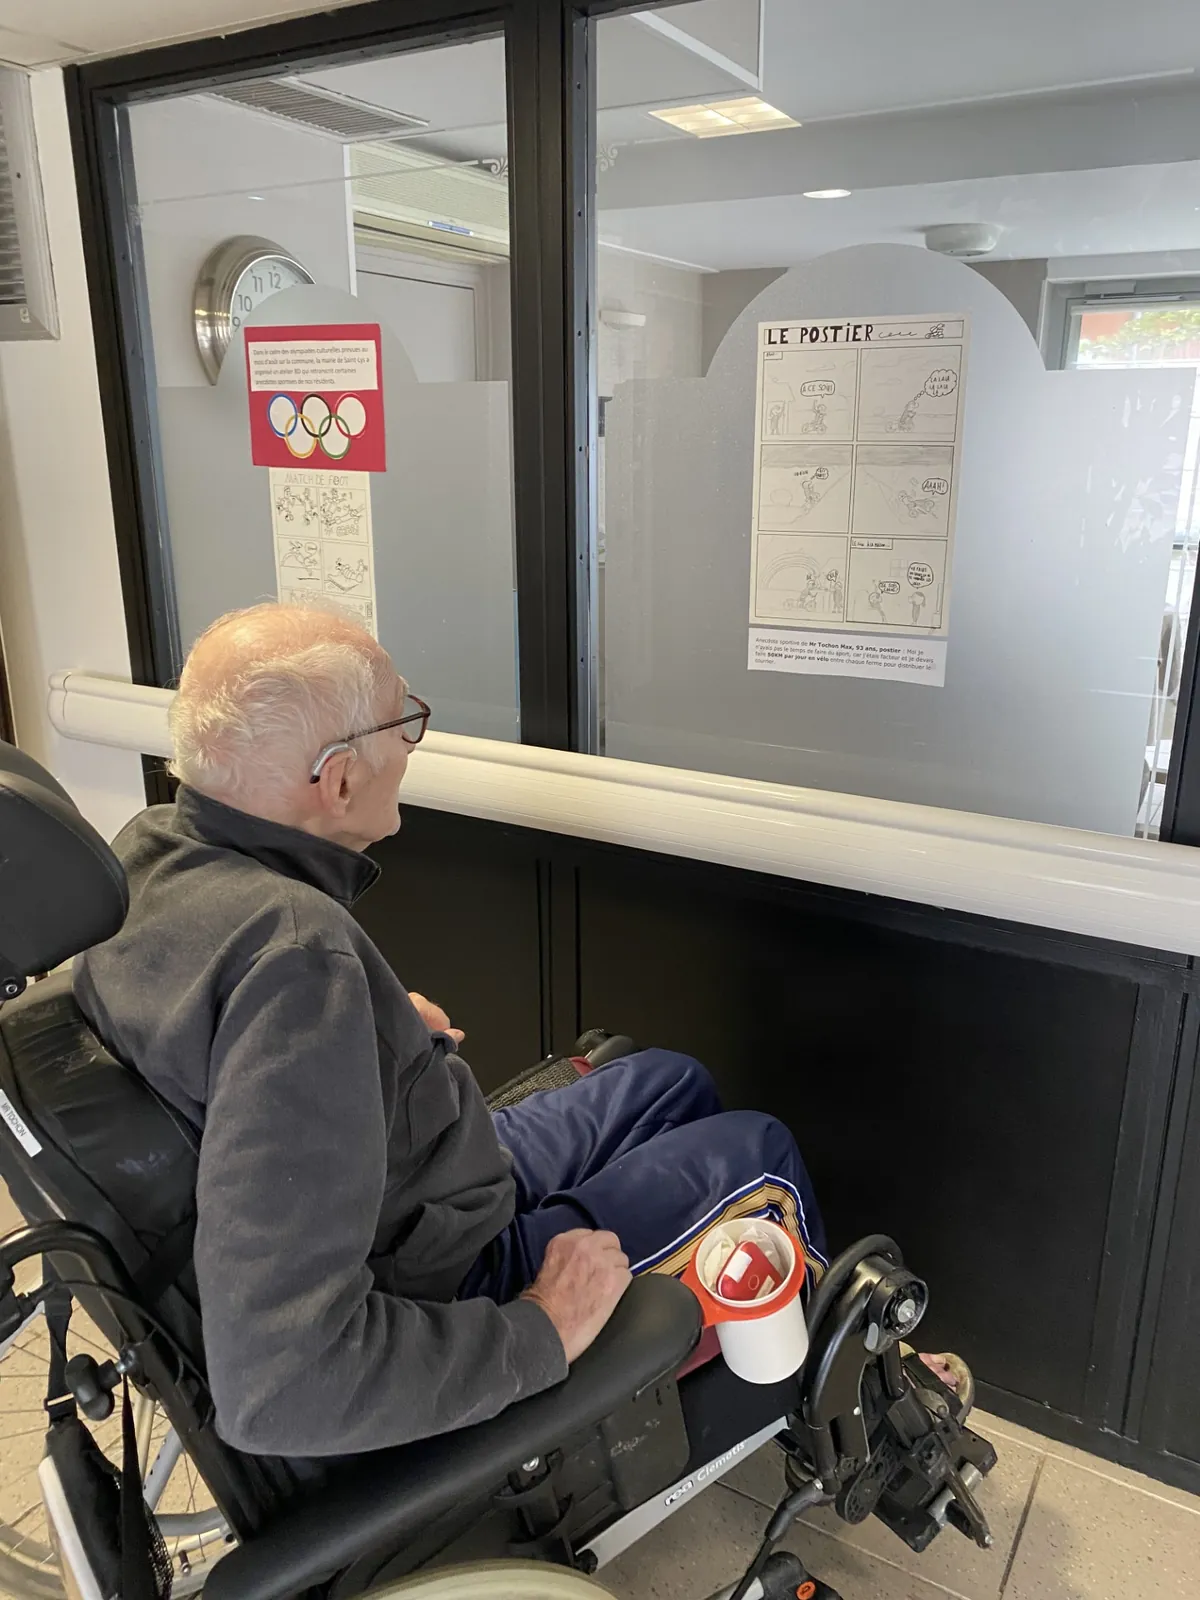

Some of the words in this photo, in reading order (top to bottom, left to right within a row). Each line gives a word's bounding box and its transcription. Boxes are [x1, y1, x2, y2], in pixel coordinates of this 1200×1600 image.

[252, 276, 263, 293] 11
[268, 272, 281, 289] 12
[238, 294, 252, 312] 10
[232, 316, 241, 332] 9
[768, 328, 788, 344] LE
[800, 323, 874, 344] POSTIER
